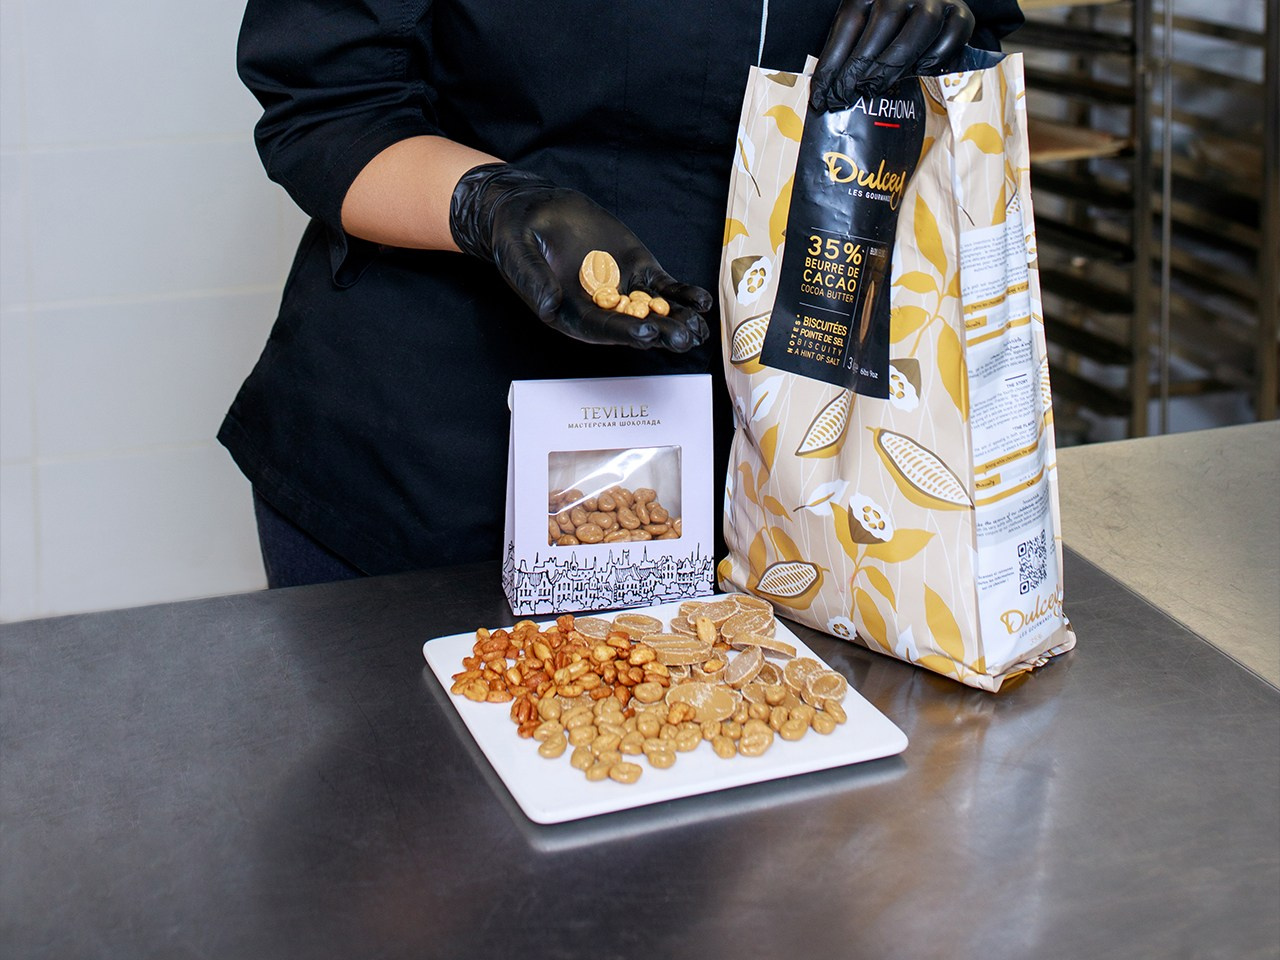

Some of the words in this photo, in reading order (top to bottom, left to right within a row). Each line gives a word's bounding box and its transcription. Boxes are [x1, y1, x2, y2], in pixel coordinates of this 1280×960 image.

[851, 96, 916, 120] ALRHONA
[822, 151, 906, 211] Dulcey
[848, 188, 863, 197] LES
[804, 257, 845, 275] BEURRE
[847, 266, 860, 279] DE
[803, 269, 857, 293] CACAO
[800, 283, 825, 297] COCOA
[826, 290, 854, 303] BUTTER
[803, 316, 847, 336] BISCUITÉES
[797, 338, 842, 356] BISCUITY
[800, 328, 823, 342] POINTE
[823, 334, 833, 344] DE
[833, 337, 844, 347] SEL
[800, 350, 815, 359] HINT
[816, 353, 825, 361] OF
[825, 356, 840, 366] SALT
[581, 404, 649, 420] TEVILLE
[568, 421, 617, 429] МАСТЕРСКАЯ
[1000, 584, 1062, 635] Dulcey
